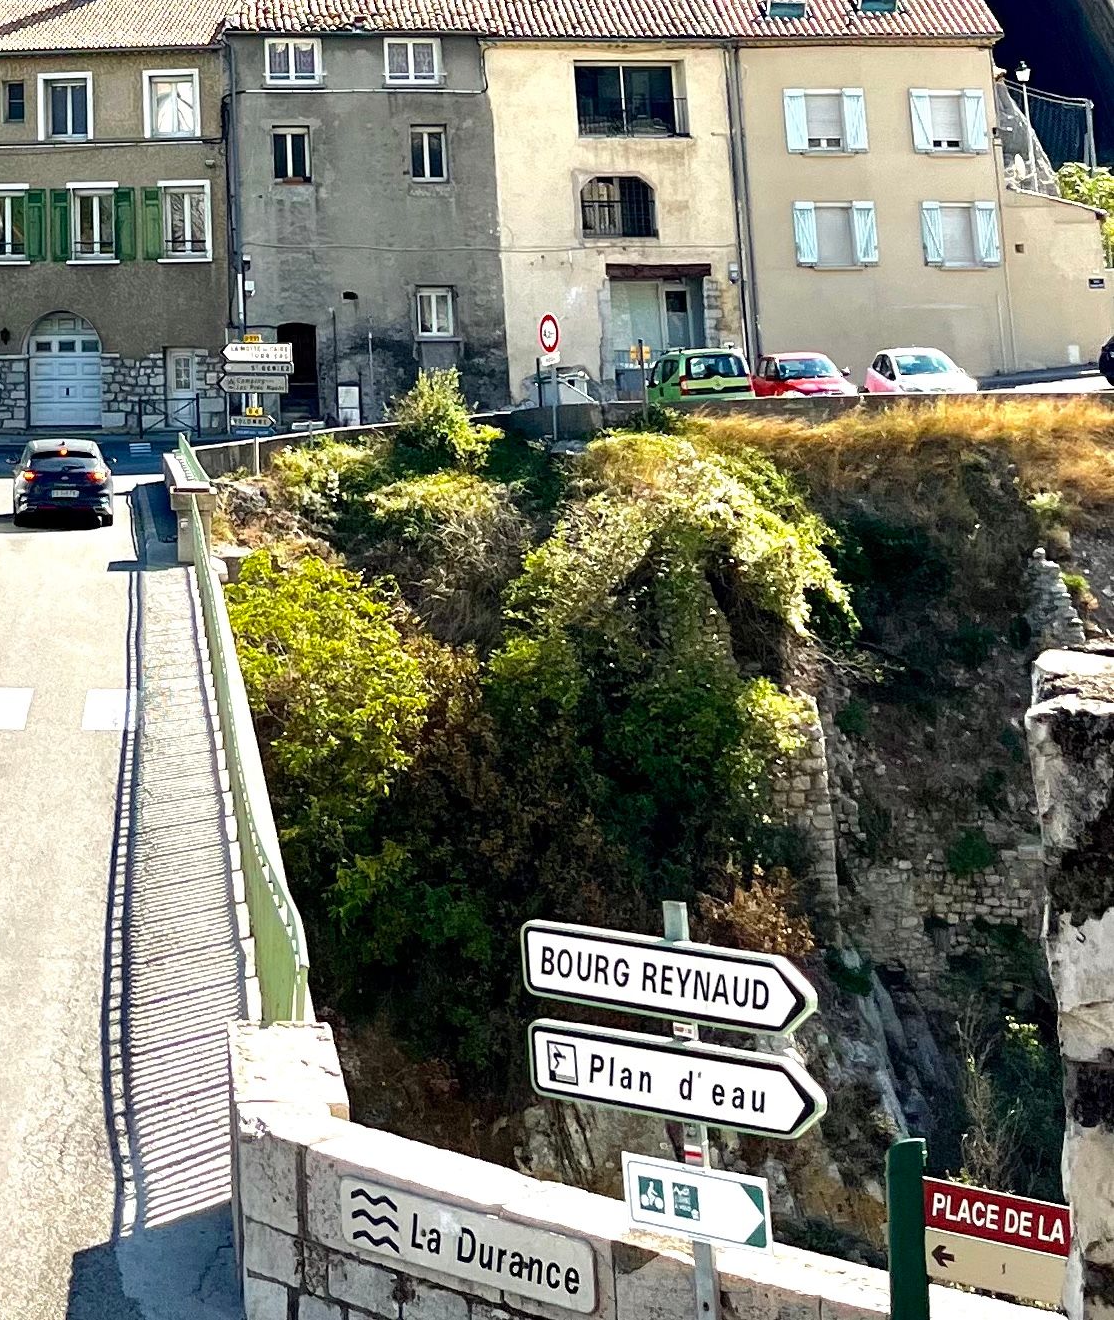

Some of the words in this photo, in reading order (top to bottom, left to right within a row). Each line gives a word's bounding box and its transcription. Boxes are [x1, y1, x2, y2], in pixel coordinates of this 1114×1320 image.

[541, 945, 630, 988] BOURG
[641, 961, 770, 1010] REYNAUD
[589, 1053, 652, 1094] Plan
[679, 1070, 766, 1114] d'eau
[932, 1192, 1000, 1230] PLACE
[1004, 1208, 1033, 1238] DE
[1038, 1214, 1065, 1245] LA
[410, 1212, 441, 1255] La
[456, 1226, 581, 1295] Durance
